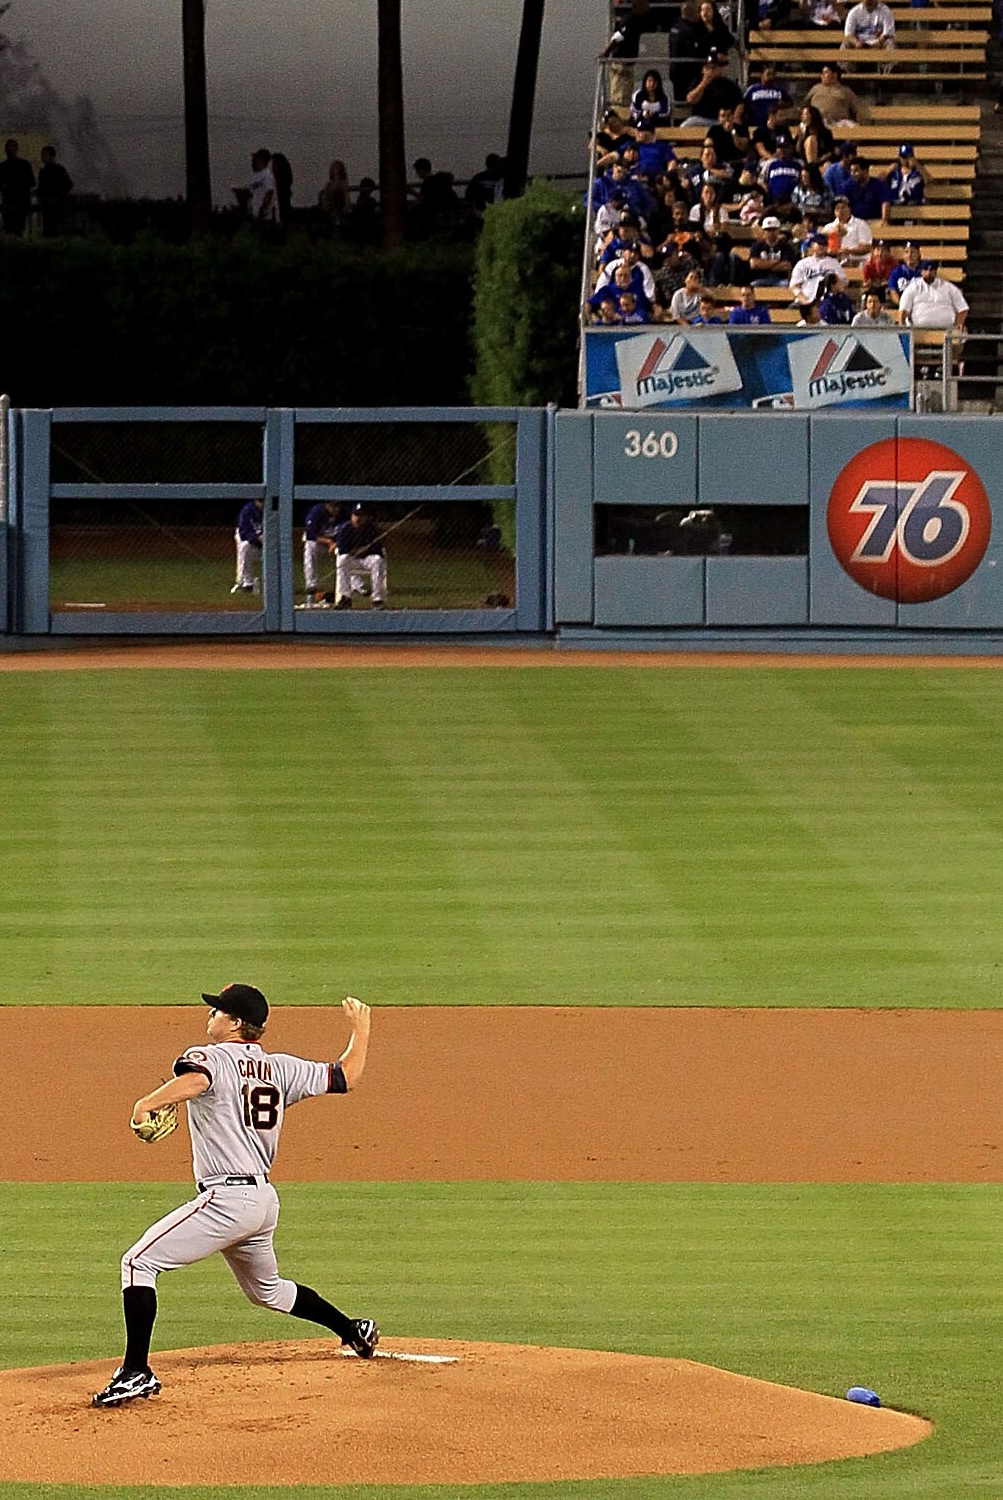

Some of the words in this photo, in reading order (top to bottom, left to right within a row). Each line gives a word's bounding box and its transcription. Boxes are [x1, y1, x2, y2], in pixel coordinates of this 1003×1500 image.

[624, 429, 678, 458] 360
[849, 470, 970, 567] 76
[238, 1059, 272, 1081] CAIN
[241, 1082, 281, 1131] 18
